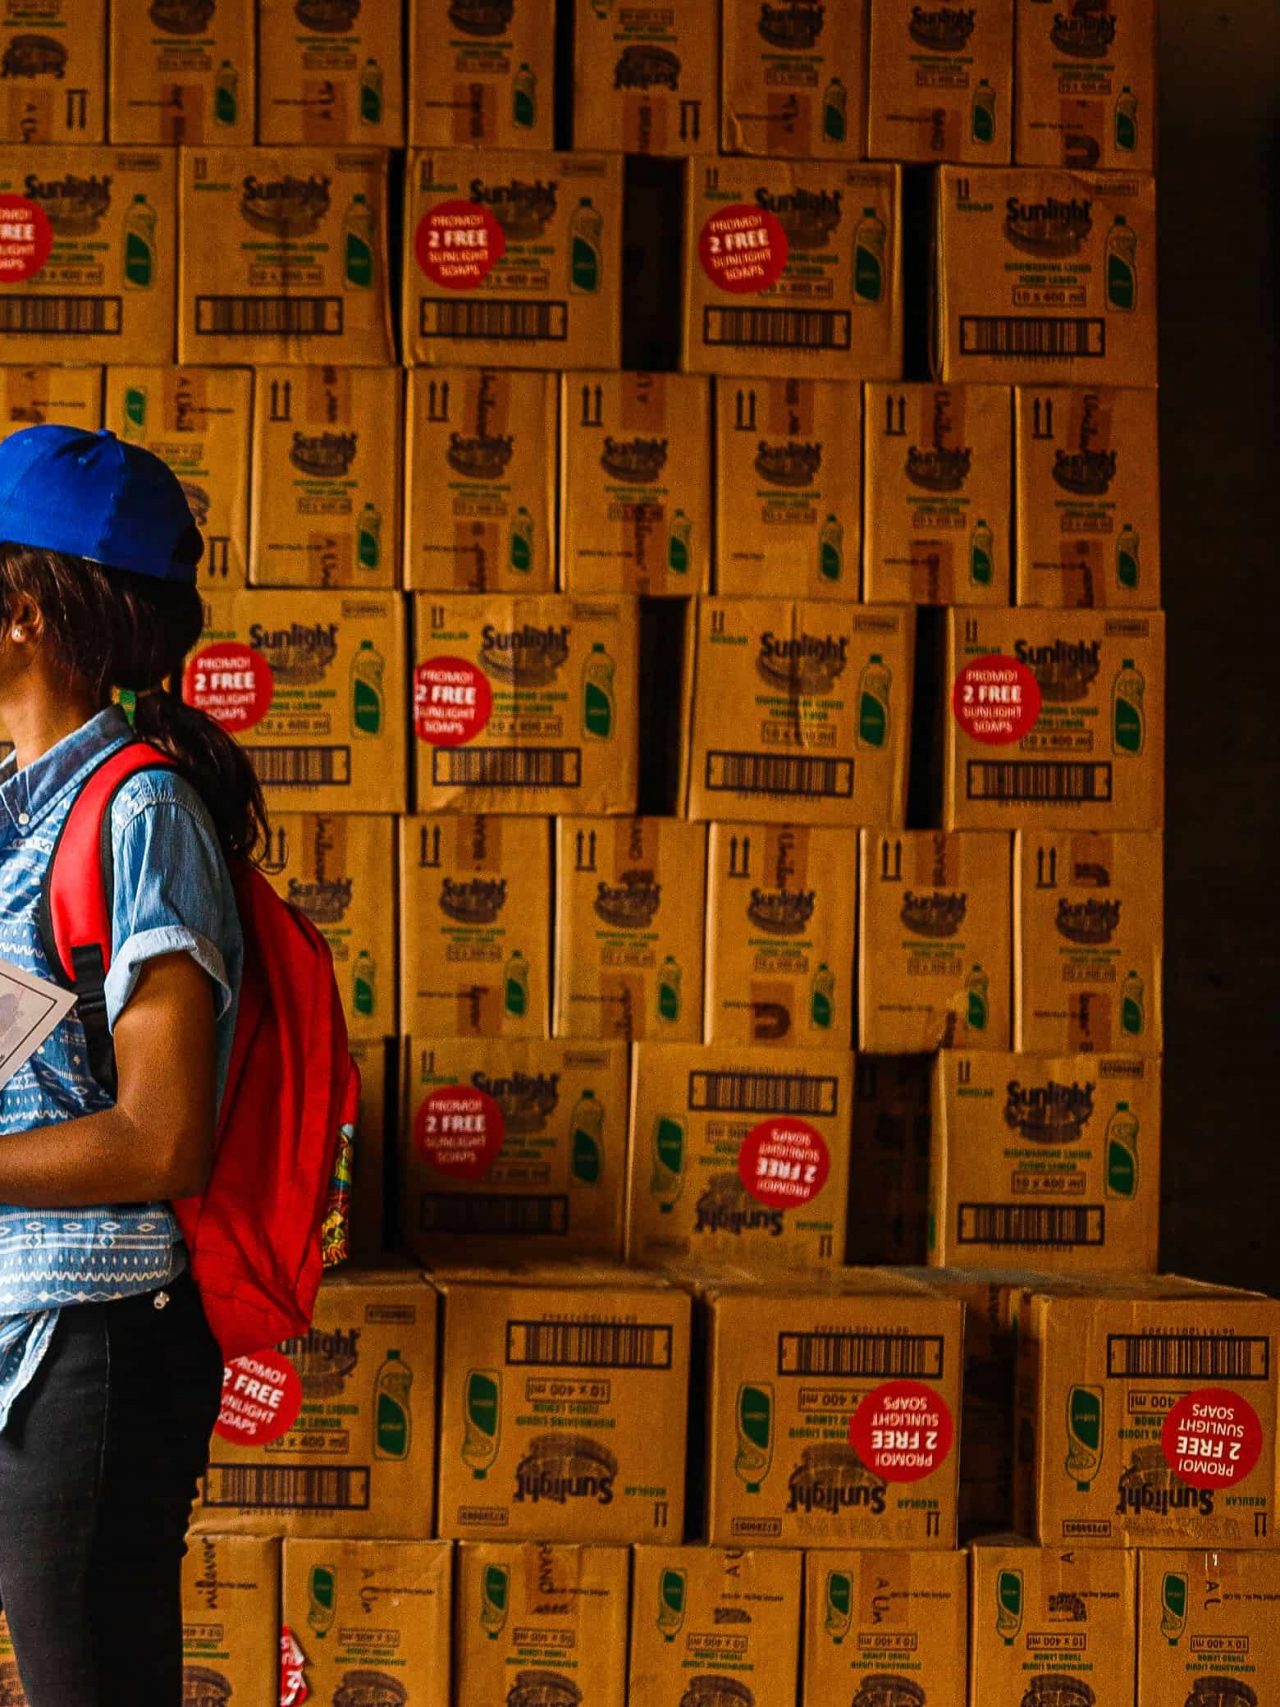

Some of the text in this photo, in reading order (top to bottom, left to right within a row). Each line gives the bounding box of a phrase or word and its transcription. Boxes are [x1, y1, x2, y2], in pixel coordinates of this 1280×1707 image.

[1007, 196, 1092, 225] Sunlight
[429, 230, 487, 248] 2 FREE
[710, 228, 769, 254] 2 FREE
[250, 622, 339, 653] Sunlight
[482, 624, 572, 653] Sunlight
[761, 631, 849, 663] Sunlight
[1014, 639, 1101, 668] Sunlight
[198, 657, 250, 670] PROMO!
[194, 672, 256, 690] 2 FREE
[420, 670, 474, 684] PROMO!
[966, 670, 1018, 683] PROMO!
[194, 692, 256, 706] SUNLIGHT
[415, 684, 476, 705] 2 FREE
[964, 685, 1022, 704] 2 FREE
[964, 705, 1022, 719] SUNLIGHT
[424, 721, 464, 735] SOAPS
[973, 721, 1012, 732] SOAPS
[1007, 1082, 1096, 1109] Sunlight
[426, 1115, 486, 1132] 2 FREE
[757, 1158, 817, 1182] 2 FREE
[757, 1180, 810, 1198] PROMO!
[234, 1374, 284, 1408] FREE
[884, 1397, 928, 1410] SOAPS
[1132, 1396, 1146, 1406] ml
[872, 1412, 938, 1426] SUNLIGHT
[1192, 1404, 1234, 1420] SOAPS
[1178, 1418, 1244, 1438] SUNLIGHT
[872, 1430, 938, 1450] 2 FREE
[1176, 1436, 1242, 1460] 2 FREE
[875, 1453, 932, 1467] PROMO!
[1178, 1458, 1234, 1477] PROMO!
[515, 1470, 614, 1504] Sunlight
[787, 1482, 888, 1514] Sunlight
[1116, 1484, 1215, 1516] Sunlight
[1226, 1497, 1266, 1506] REGULAR
[1030, 1637, 1040, 1646] ml
[1044, 1636, 1060, 1646] 400
[1073, 1636, 1084, 1646] 10
[1192, 1639, 1204, 1648] ml
[1207, 1639, 1224, 1648] 400
[1236, 1640, 1246, 1649] 10
